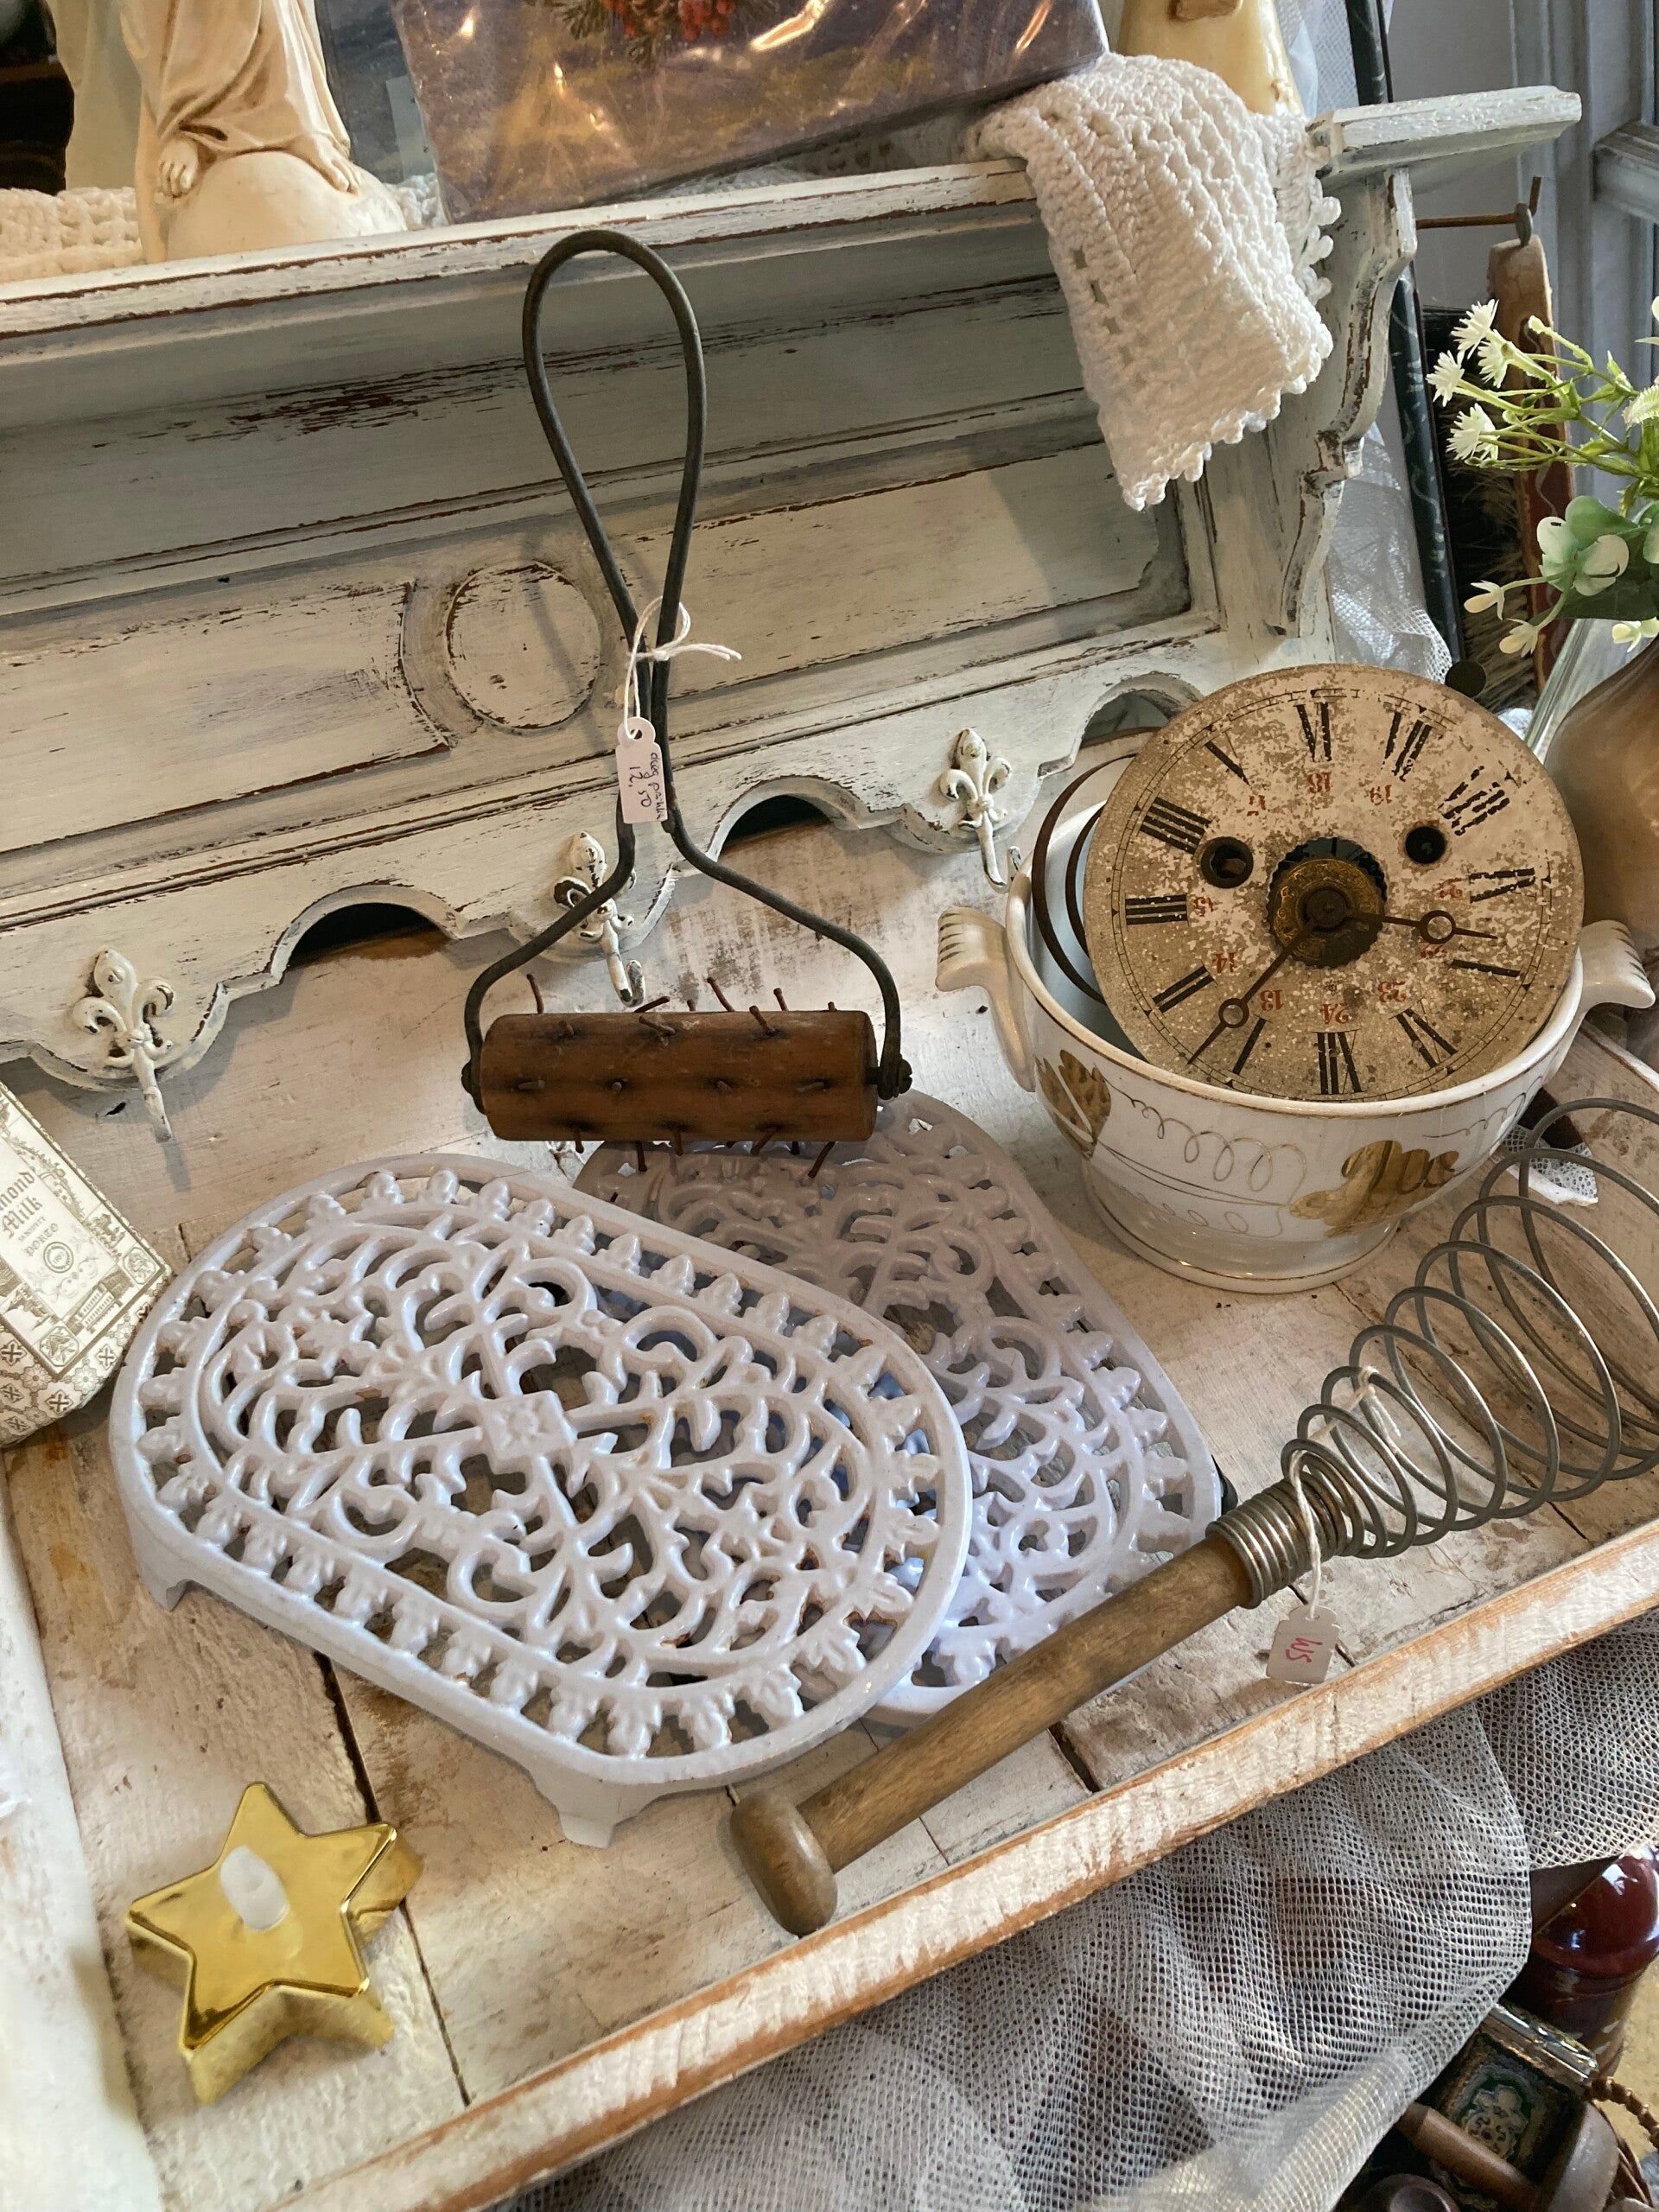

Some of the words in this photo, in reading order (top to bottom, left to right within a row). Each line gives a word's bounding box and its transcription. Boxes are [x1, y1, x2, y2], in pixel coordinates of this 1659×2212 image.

[1124, 893, 1190, 930] III
[1212, 951, 1237, 975] 14
[1259, 988, 1284, 1012] 13
[1376, 980, 1407, 1003] 23
[1319, 1002, 1351, 1025] 24
[1313, 1029, 1365, 1095] XII
[3, 1196, 43, 1239] Milk
[23, 1223, 59, 1257] PORTO
